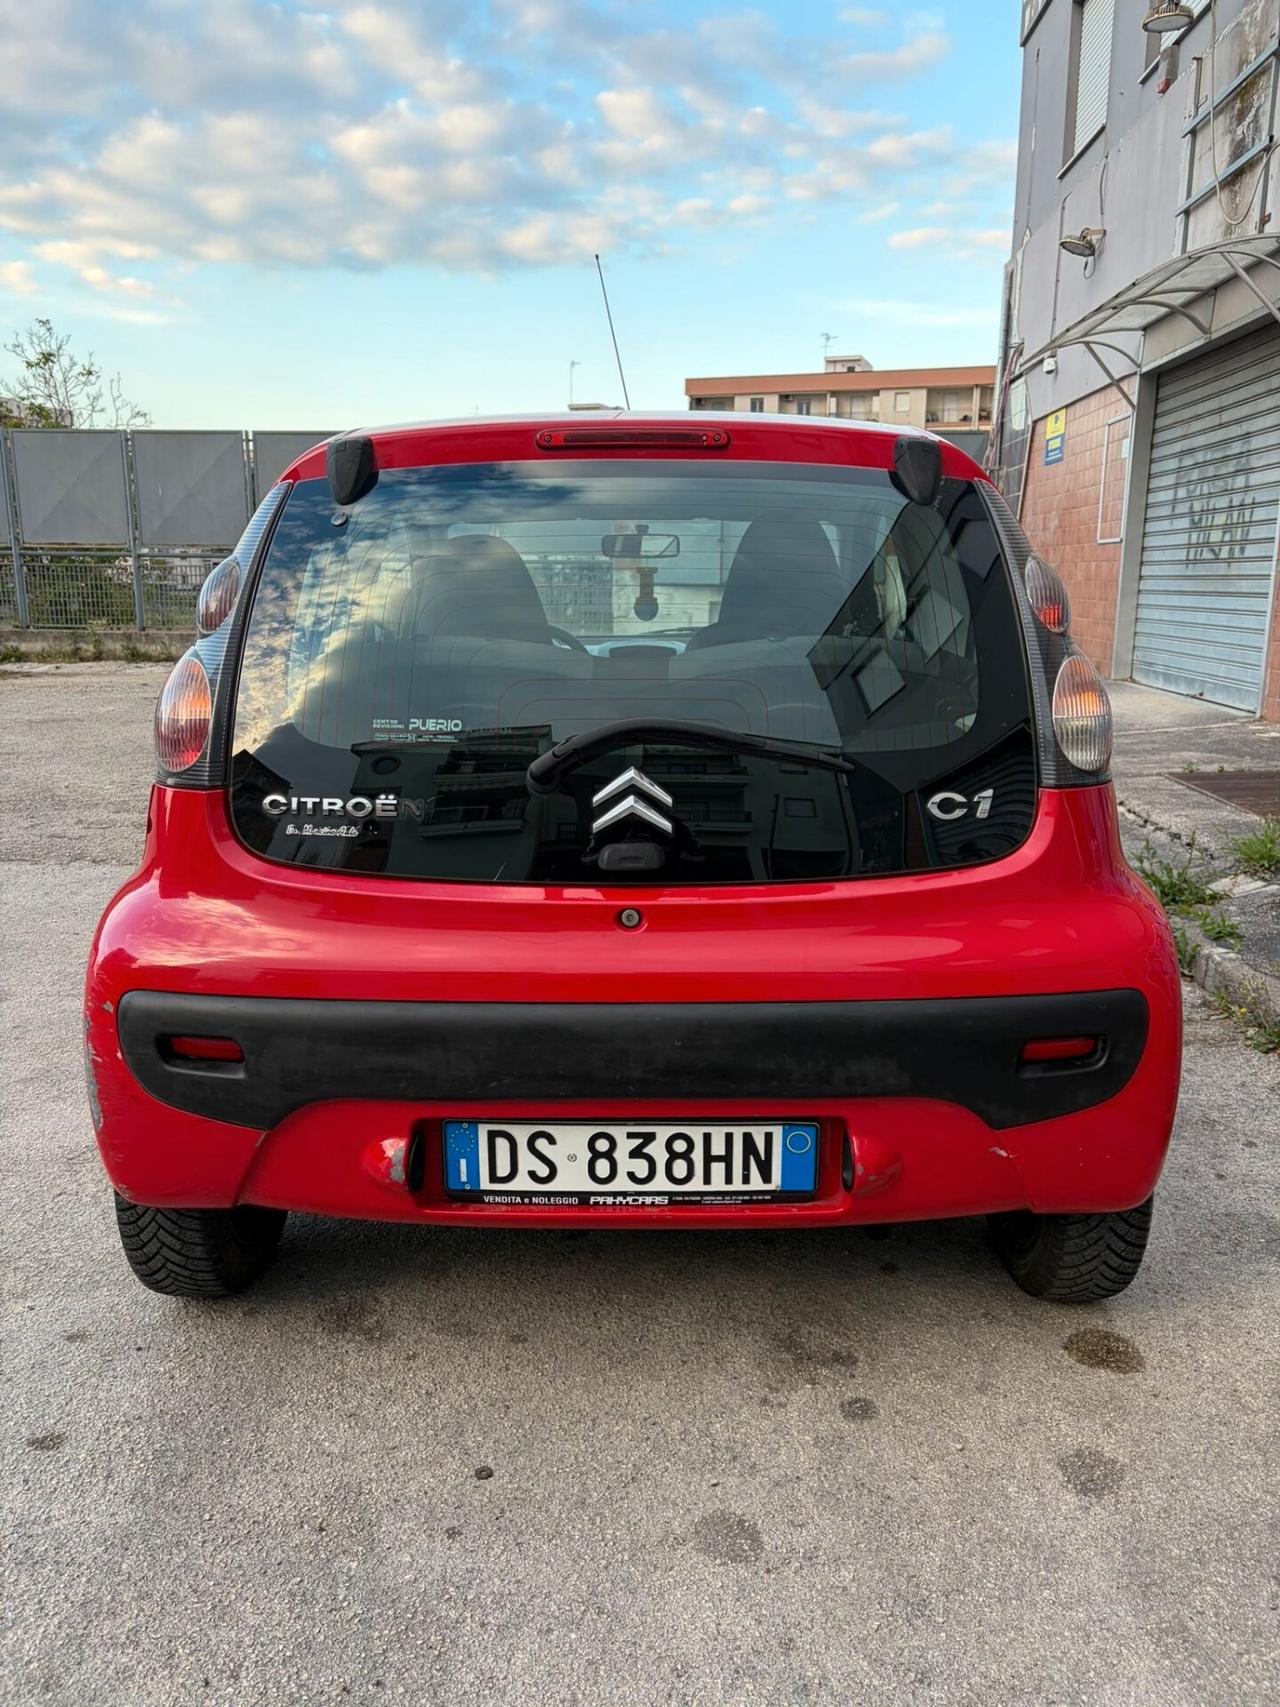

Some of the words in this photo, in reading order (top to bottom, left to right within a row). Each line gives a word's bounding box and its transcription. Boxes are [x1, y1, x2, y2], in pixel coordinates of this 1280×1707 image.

[408, 718, 462, 731] PUERIO
[262, 794, 424, 817] CITROËN
[927, 788, 994, 820] C1
[487, 1129, 557, 1185] DS
[587, 1131, 774, 1185] 838HN
[483, 1195, 522, 1204] VENDITA
[532, 1196, 579, 1205] NOLEGGIO
